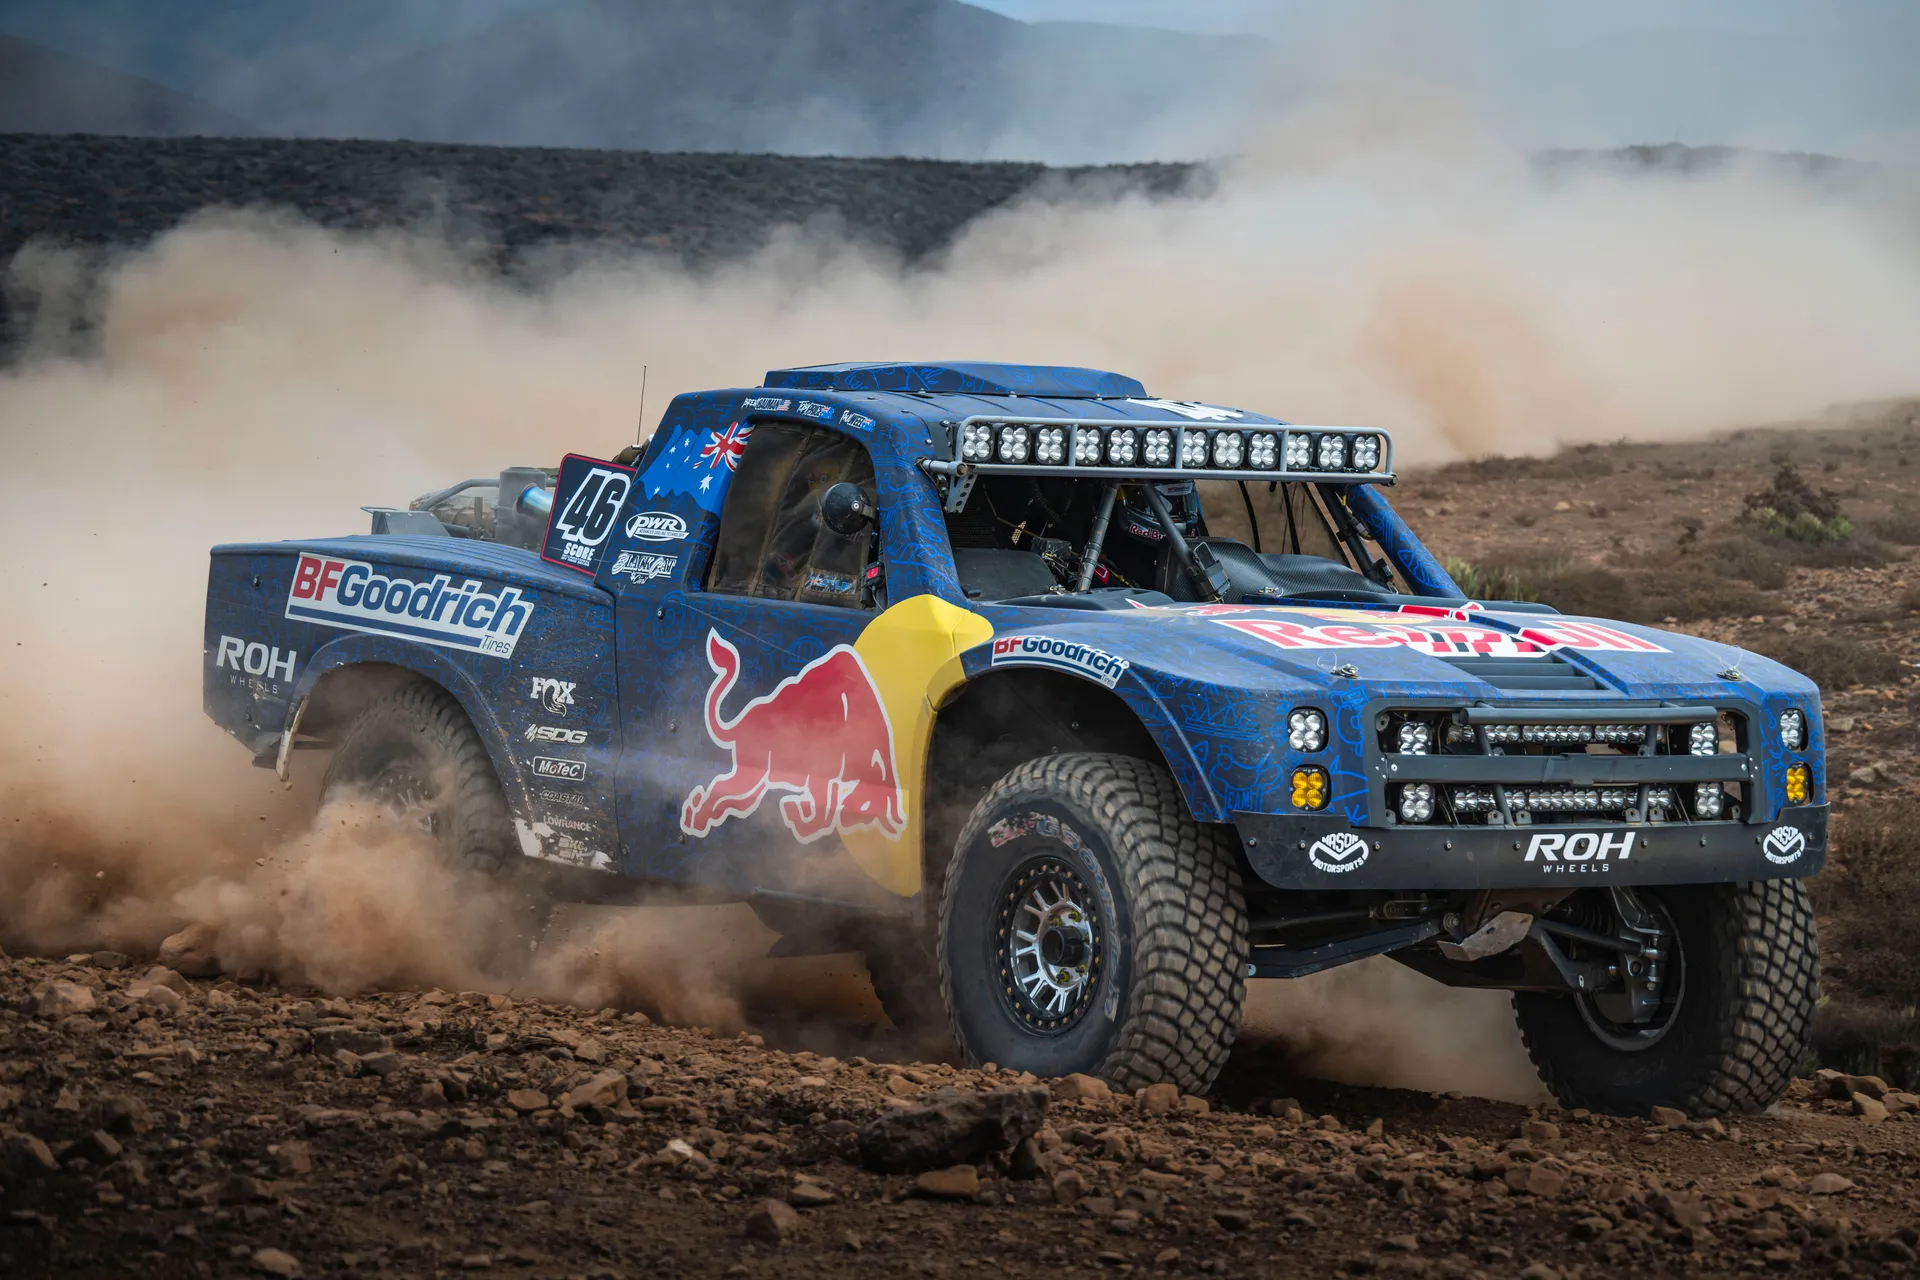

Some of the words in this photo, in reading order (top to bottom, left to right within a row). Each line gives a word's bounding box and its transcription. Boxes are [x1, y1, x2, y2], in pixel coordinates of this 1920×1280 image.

[556, 467, 631, 546] 46
[630, 515, 681, 533] PWR
[1129, 523, 1151, 537] Red
[563, 542, 596, 561] SCORE
[292, 557, 526, 636] BFGoodrich
[481, 634, 512, 654] Tires
[216, 634, 297, 683] ROH
[994, 636, 1122, 679] BFGoodrich
[530, 676, 577, 706] FOX
[535, 725, 588, 744] SDG
[538, 760, 581, 777] MoTeC
[543, 815, 593, 832] LOWRANCE
[1321, 832, 1359, 853] MASON
[1771, 825, 1799, 845] MASON
[1523, 831, 1636, 862] ROH
[1312, 856, 1364, 873] MOTORSPORTS
[1543, 863, 1610, 873] WHEELS
